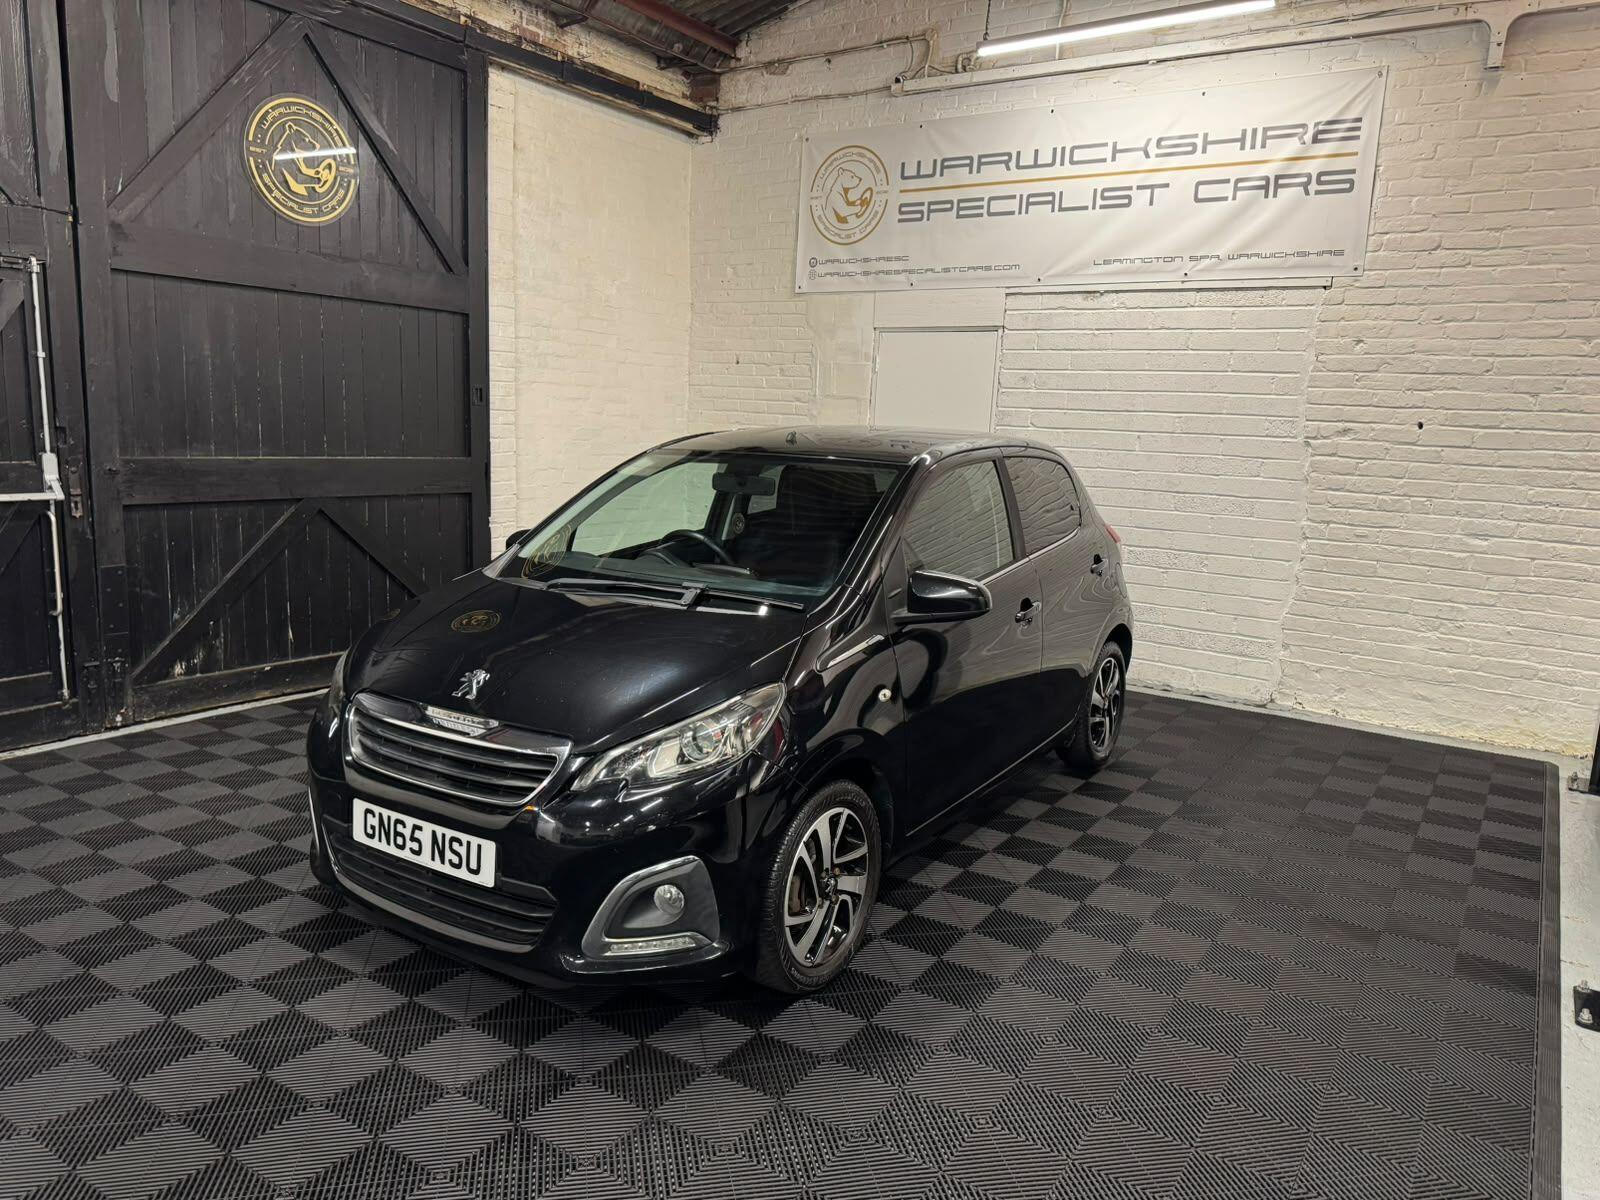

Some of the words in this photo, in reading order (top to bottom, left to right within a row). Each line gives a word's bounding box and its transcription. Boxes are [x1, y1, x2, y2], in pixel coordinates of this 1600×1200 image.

[261, 106, 343, 147] WARWICKSHIRE
[900, 116, 1363, 181] WARWICKSHIRE
[262, 172, 319, 214] SPECIALIST
[321, 189, 345, 213] CARS
[897, 182, 1170, 223] SPECIALIST
[1193, 168, 1357, 204] CARS
[1093, 255, 1184, 266] LEAMINGTON
[1188, 253, 1223, 263] SPA,
[1227, 248, 1345, 261] WARWICKSHIRE
[363, 807, 423, 857] GN65
[430, 829, 482, 876] NSU
